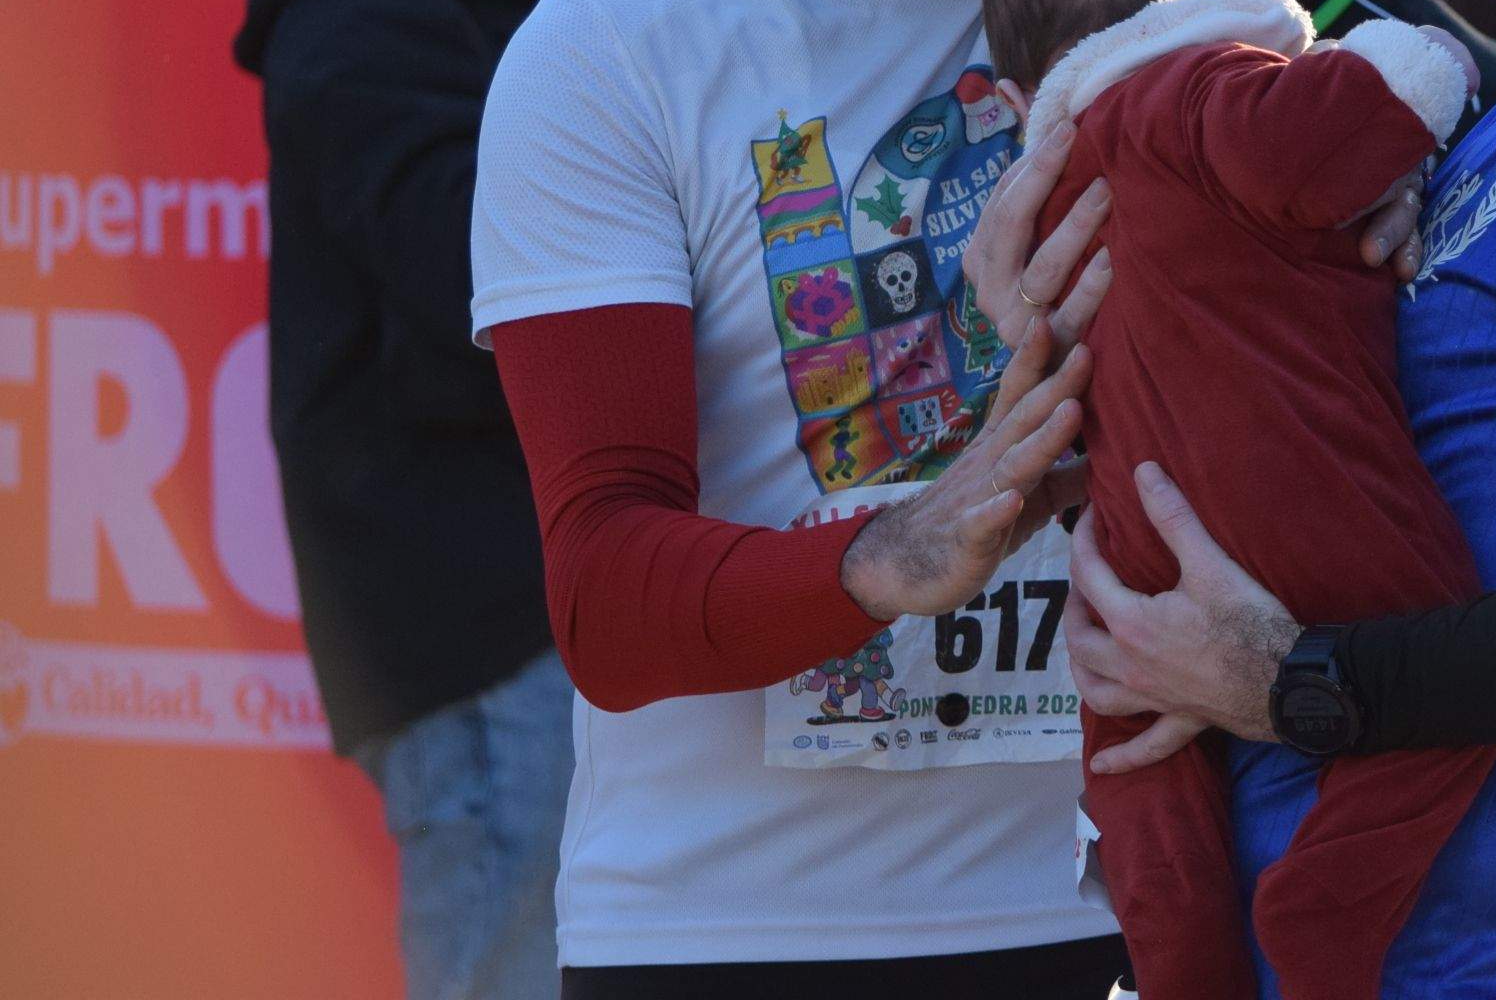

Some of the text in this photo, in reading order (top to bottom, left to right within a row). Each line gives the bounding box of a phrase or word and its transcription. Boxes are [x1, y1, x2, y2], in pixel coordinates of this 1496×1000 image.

[940, 149, 1012, 205] XL SAN
[926, 185, 996, 238] SILVE
[935, 579, 1070, 674] 617
[899, 694, 1027, 719] PONEDRA
